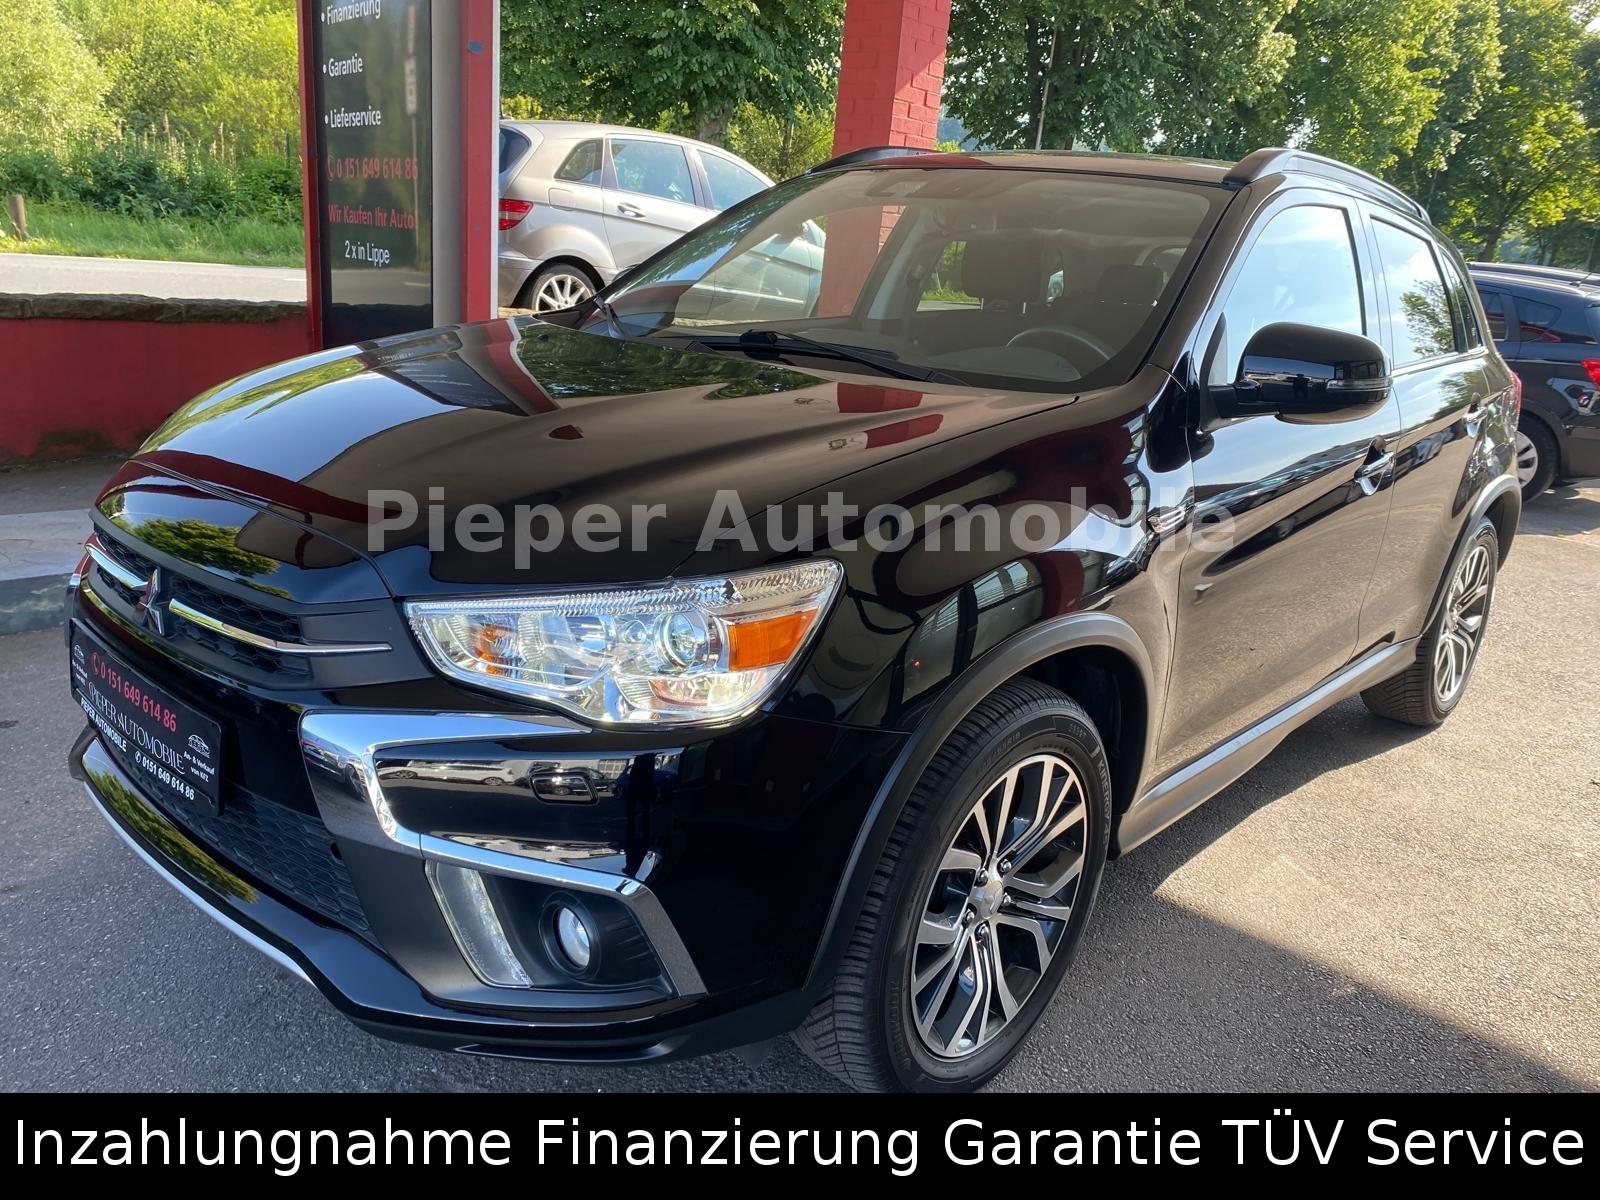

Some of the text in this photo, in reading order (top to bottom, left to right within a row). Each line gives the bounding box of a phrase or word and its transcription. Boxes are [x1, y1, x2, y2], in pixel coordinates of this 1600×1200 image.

[327, 0, 381, 25] Finanzierung
[328, 53, 363, 77] Garantie
[330, 105, 381, 128] Lieferservice
[345, 158, 359, 179] 151
[362, 158, 380, 179] 649
[382, 158, 401, 180] 614
[404, 157, 418, 180] 86
[328, 204, 341, 223] Wir
[343, 205, 372, 225] Kaufen
[375, 206, 386, 227] Ihr
[344, 240, 350, 258] 2
[357, 241, 365, 260] in
[366, 243, 390, 267] Lippe
[107, 668, 121, 692] 151
[124, 681, 140, 706] 649
[143, 695, 161, 721] 614
[163, 709, 177, 732] 86
[80, 697, 95, 720] PIEPER
[95, 715, 127, 752] AUTOMOBILE
[117, 712, 185, 775] AUTOMOBILE
[142, 756, 195, 800] 0151 649 614 86
